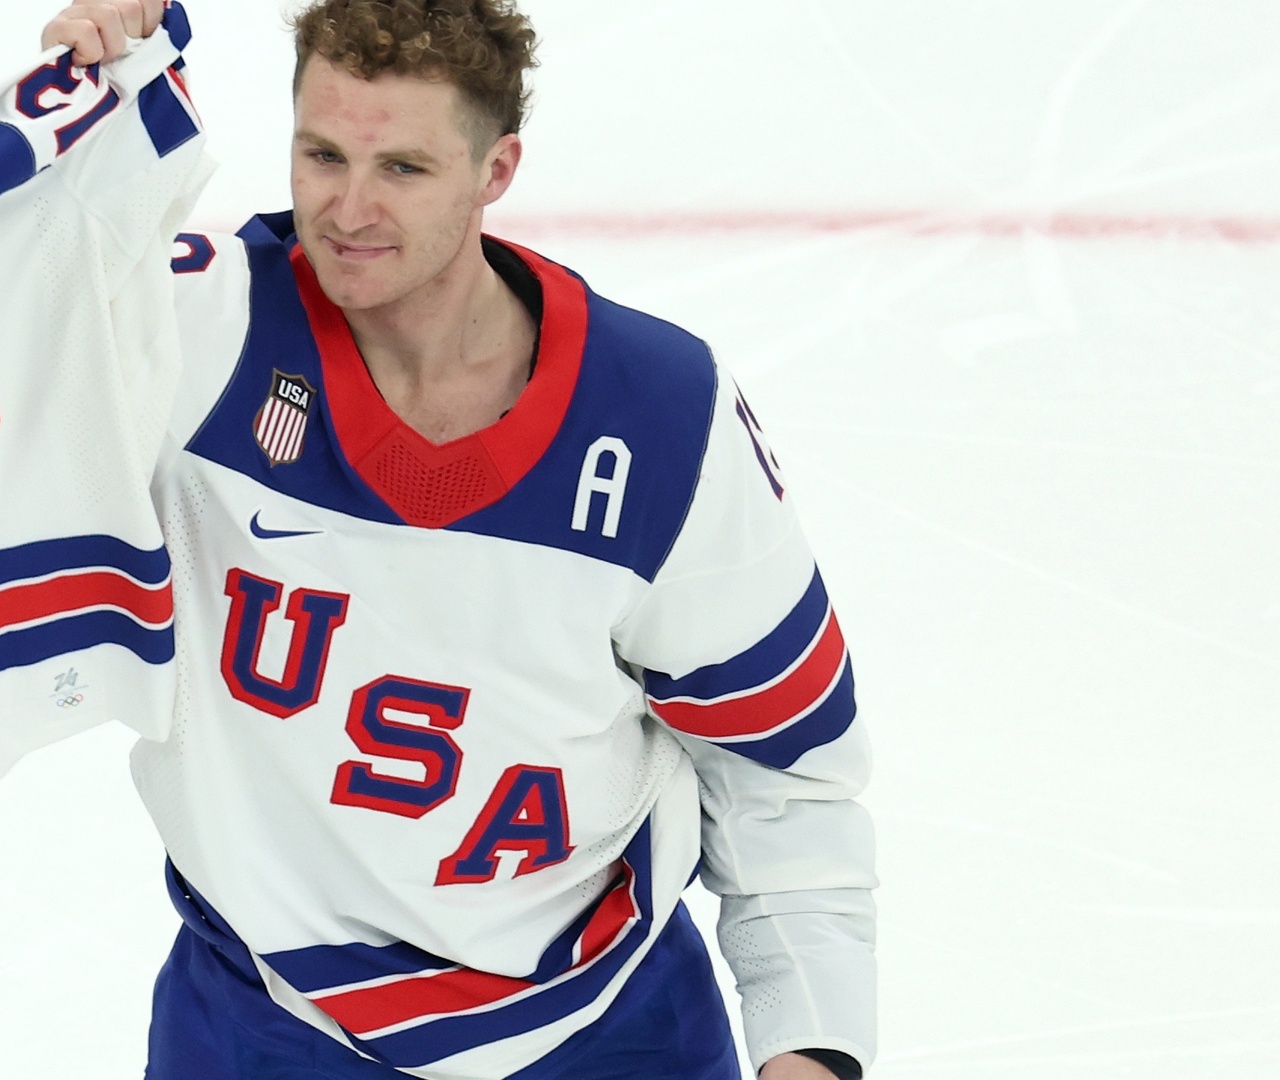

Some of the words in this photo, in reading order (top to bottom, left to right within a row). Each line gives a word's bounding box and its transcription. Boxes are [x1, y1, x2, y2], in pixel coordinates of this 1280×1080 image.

[278, 378, 309, 409] USA
[571, 436, 632, 539] A
[221, 567, 577, 886] USA
